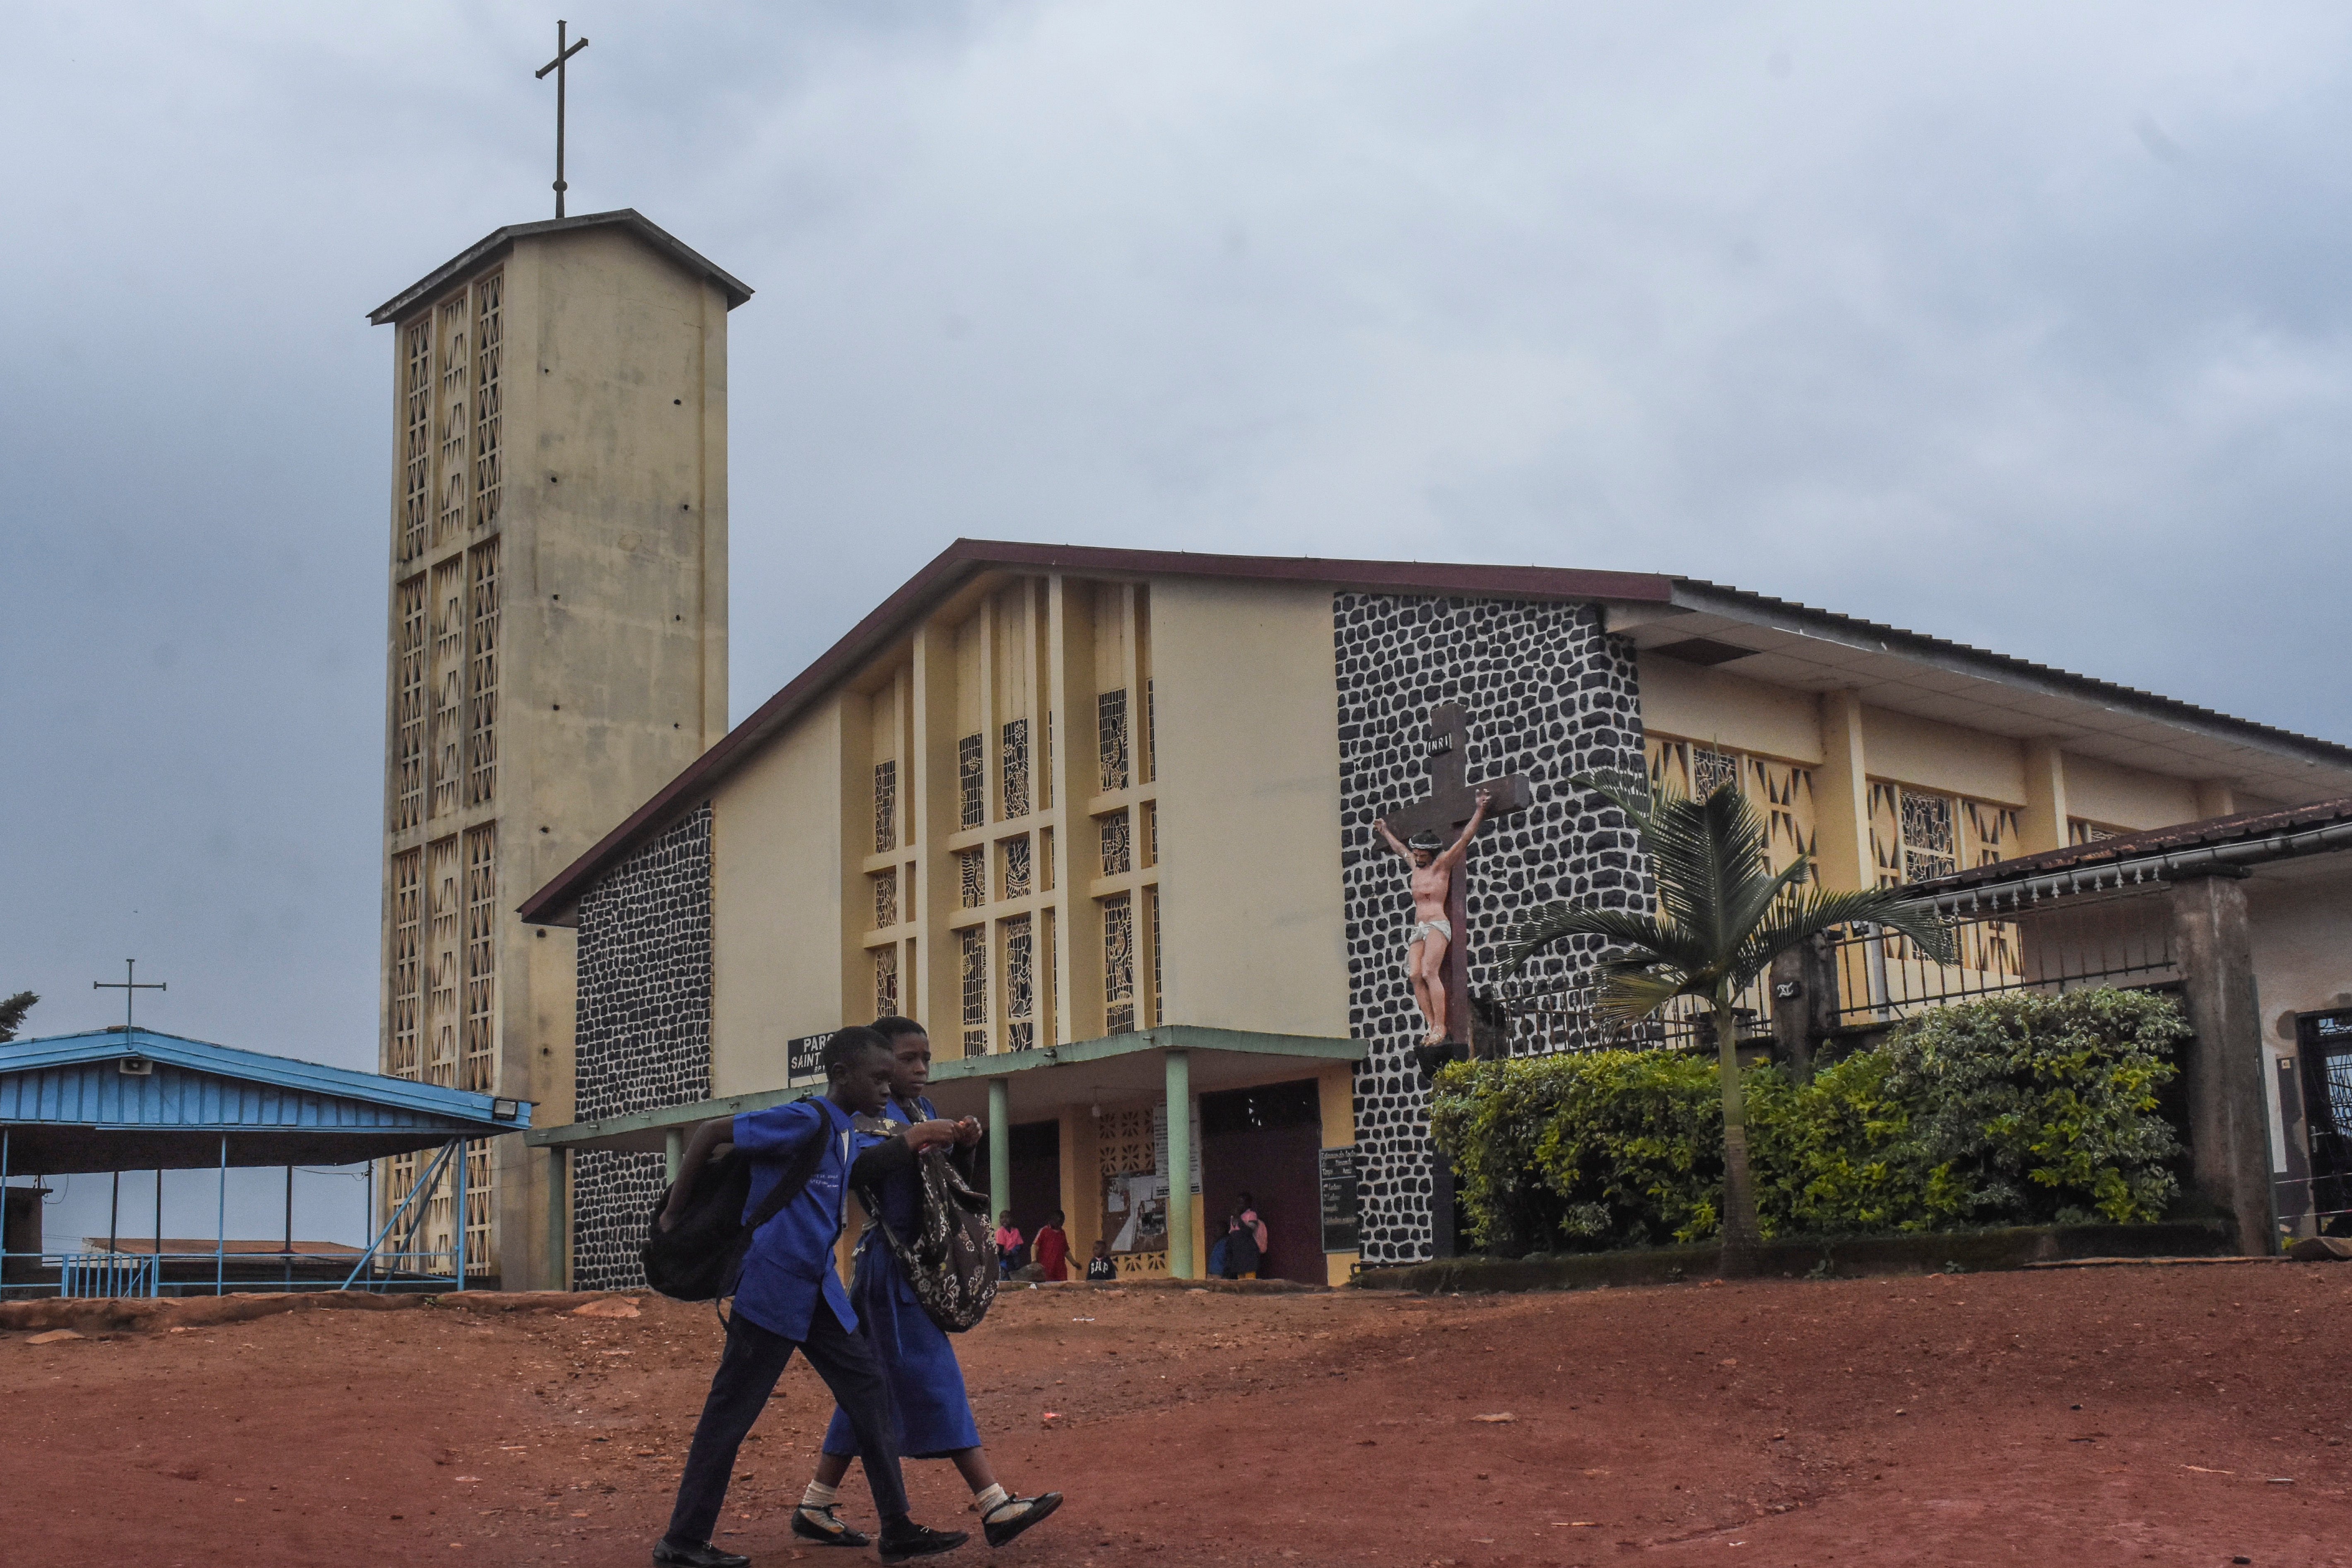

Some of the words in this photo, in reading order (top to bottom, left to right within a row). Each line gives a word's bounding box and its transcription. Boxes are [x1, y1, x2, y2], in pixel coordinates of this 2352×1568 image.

[1428, 735, 1448, 753] INRI
[791, 1052, 821, 1069] SAINT
[1091, 1261, 1109, 1274] GAP
